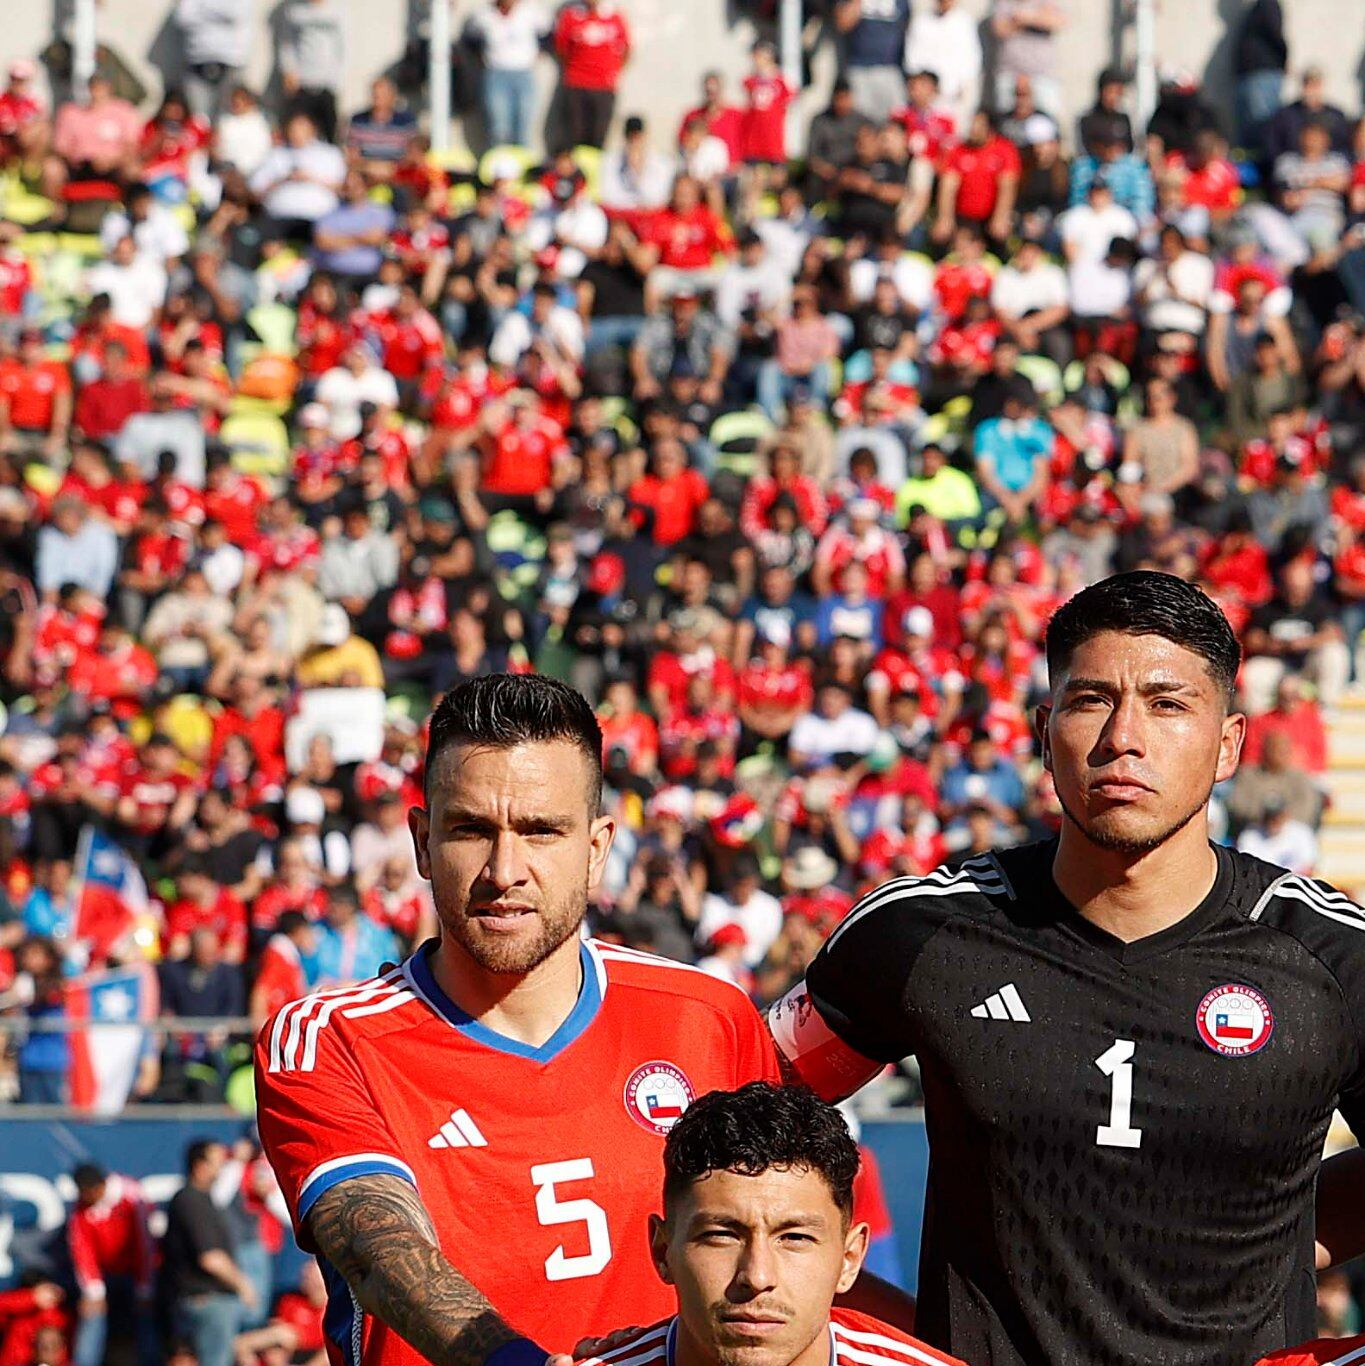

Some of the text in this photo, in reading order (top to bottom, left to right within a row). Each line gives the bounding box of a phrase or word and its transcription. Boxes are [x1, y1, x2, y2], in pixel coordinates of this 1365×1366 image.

[1200, 987, 1270, 1017] COMITE OLIMPICO
[1217, 1045, 1250, 1054] CHILE
[629, 1067, 691, 1098] COMITE OLIMPICO
[1094, 1038, 1142, 1148] 1
[530, 1157, 613, 1281] 5
